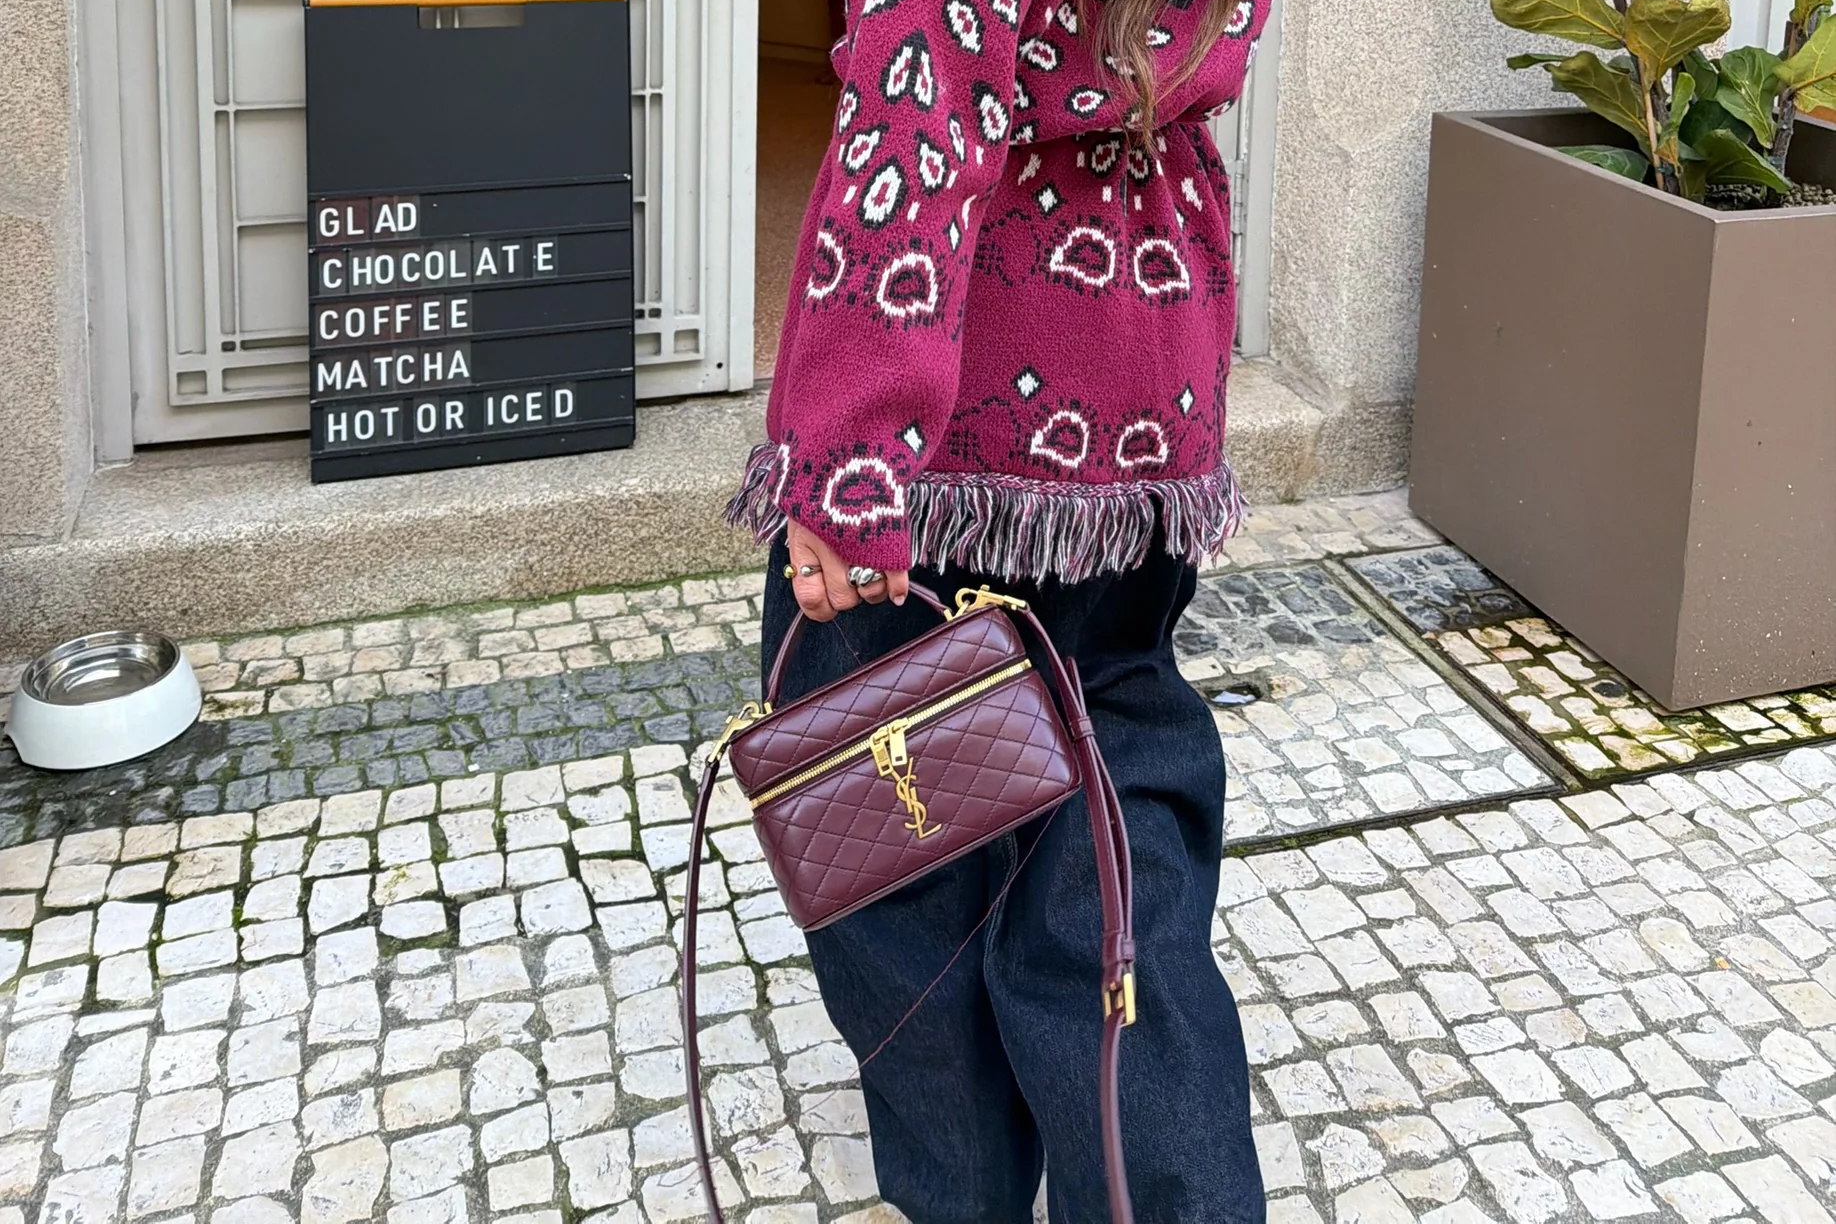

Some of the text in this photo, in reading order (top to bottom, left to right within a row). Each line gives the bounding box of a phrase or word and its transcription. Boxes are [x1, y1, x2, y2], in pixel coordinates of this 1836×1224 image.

[318, 201, 418, 238] GLAD
[318, 298, 469, 341] COFFEE
[316, 349, 471, 393] MATCHA
[326, 388, 574, 443] HOT OR ICED
